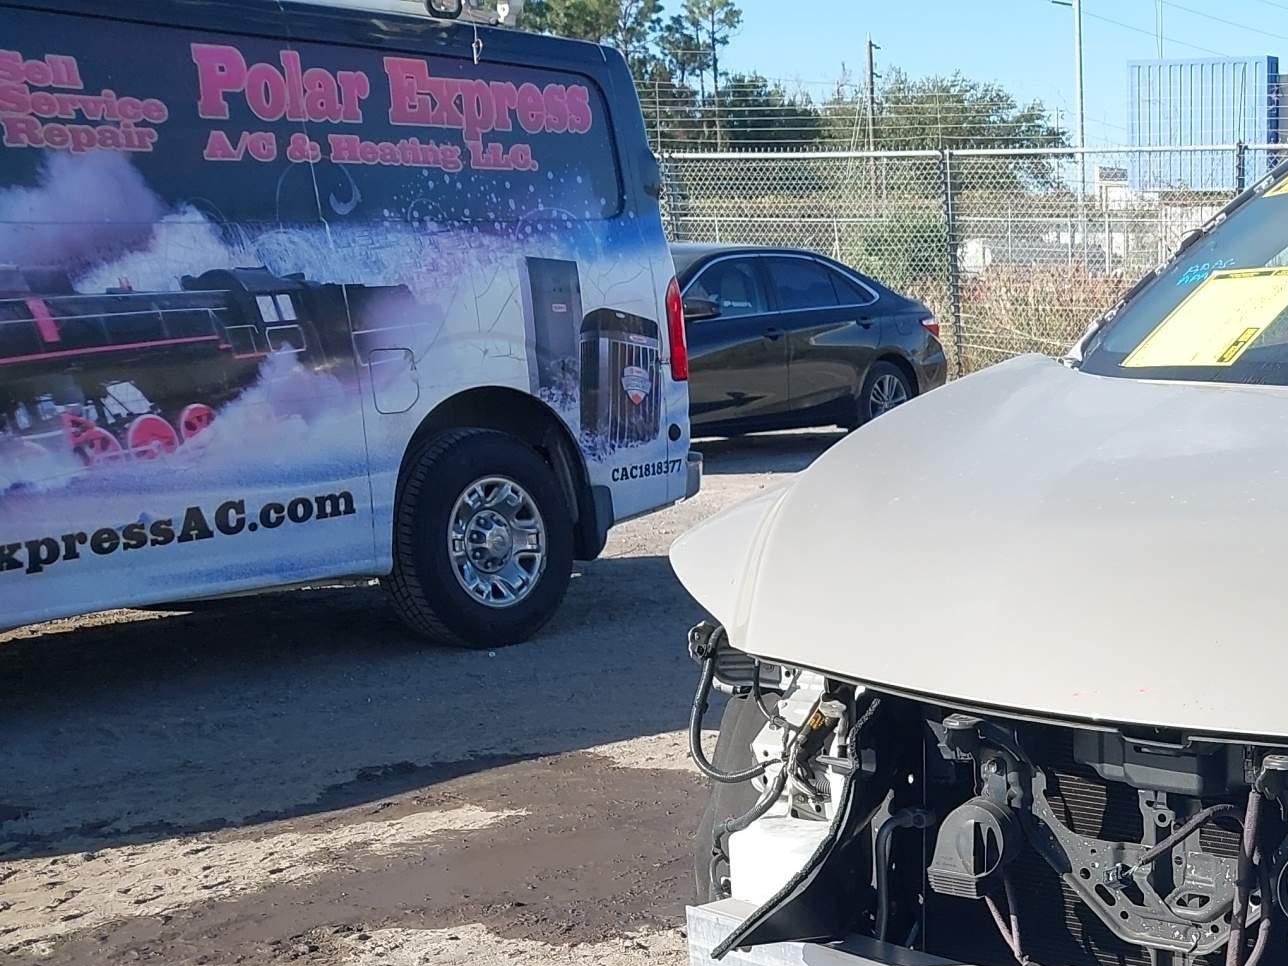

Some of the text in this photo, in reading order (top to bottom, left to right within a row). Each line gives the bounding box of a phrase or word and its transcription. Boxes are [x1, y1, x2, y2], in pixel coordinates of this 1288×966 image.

[0, 84, 168, 123] Service
[190, 43, 593, 142] Polar Express
[1, 115, 158, 153] Repair
[204, 130, 276, 161] A/C
[287, 135, 321, 163] &
[330, 134, 462, 172] Heating
[612, 458, 682, 482] CAC1818377
